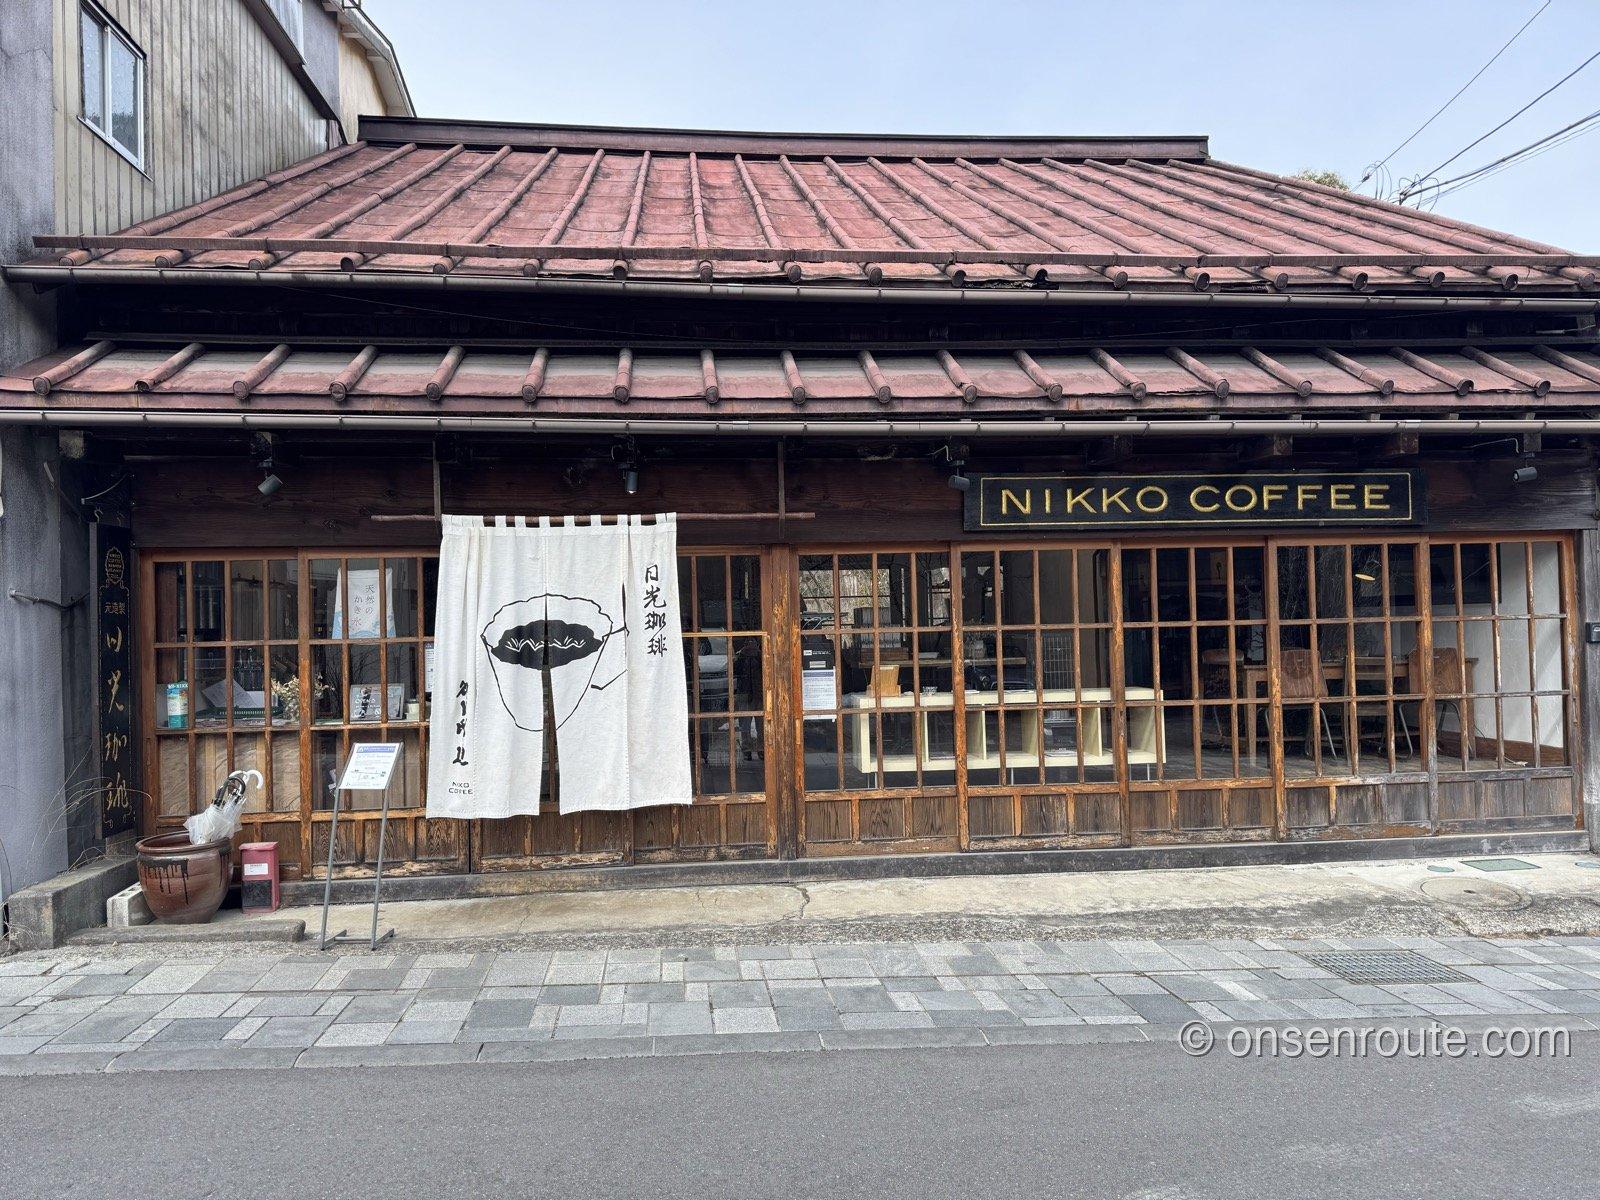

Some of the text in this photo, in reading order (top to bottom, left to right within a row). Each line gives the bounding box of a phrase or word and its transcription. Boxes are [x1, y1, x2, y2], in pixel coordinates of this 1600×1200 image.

[1001, 484, 1391, 515] NIKKO COFFEE
[643, 564, 668, 657] 日光珈琲
